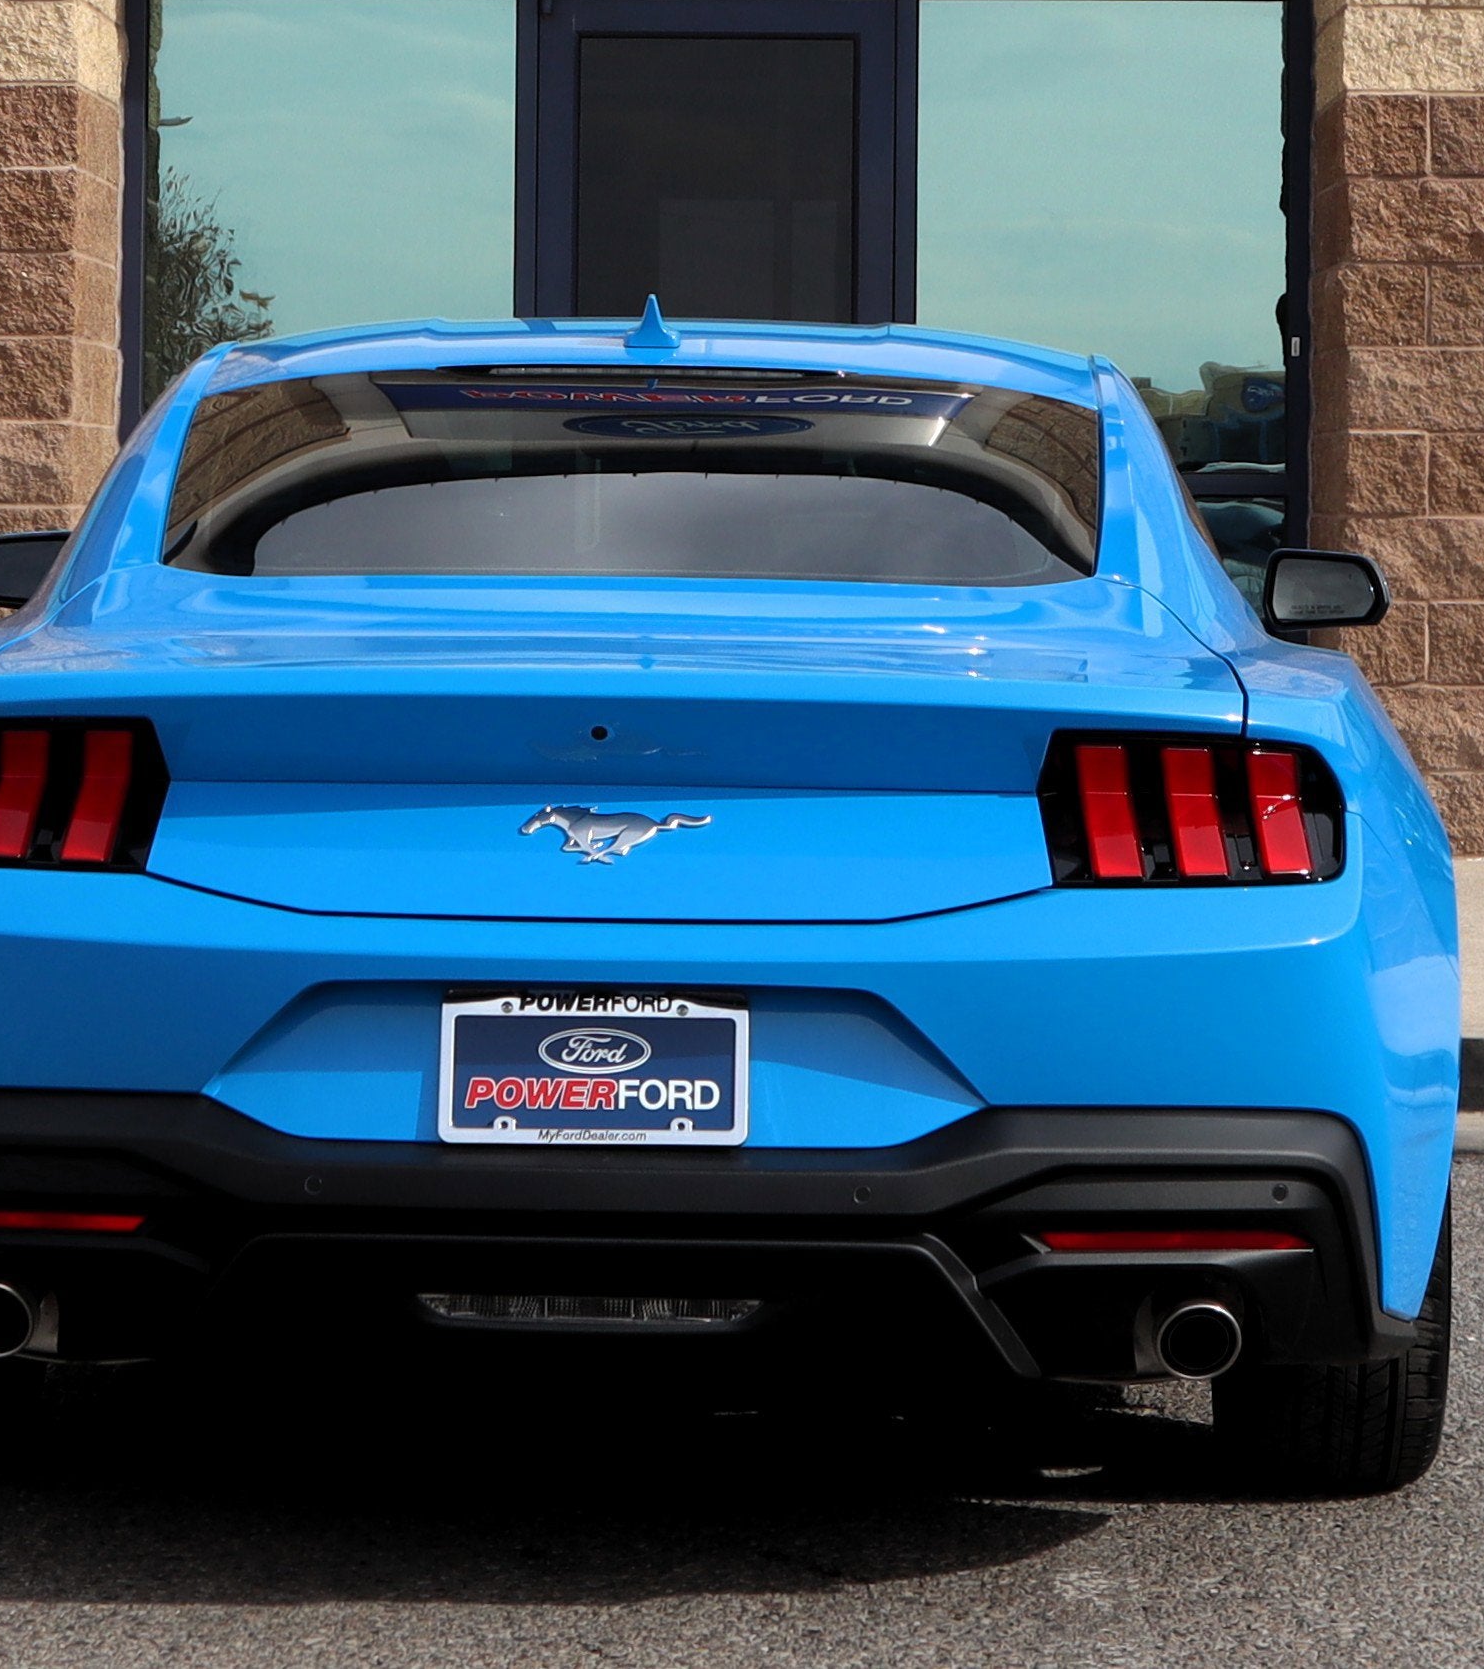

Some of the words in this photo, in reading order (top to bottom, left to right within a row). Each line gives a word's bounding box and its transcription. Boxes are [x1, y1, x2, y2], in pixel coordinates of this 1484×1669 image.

[519, 994, 672, 1013] POWERFORD
[561, 1035, 628, 1063] Ford
[464, 1077, 721, 1111] POWERFORD
[537, 1128, 647, 1144] MyFordDealer.com
